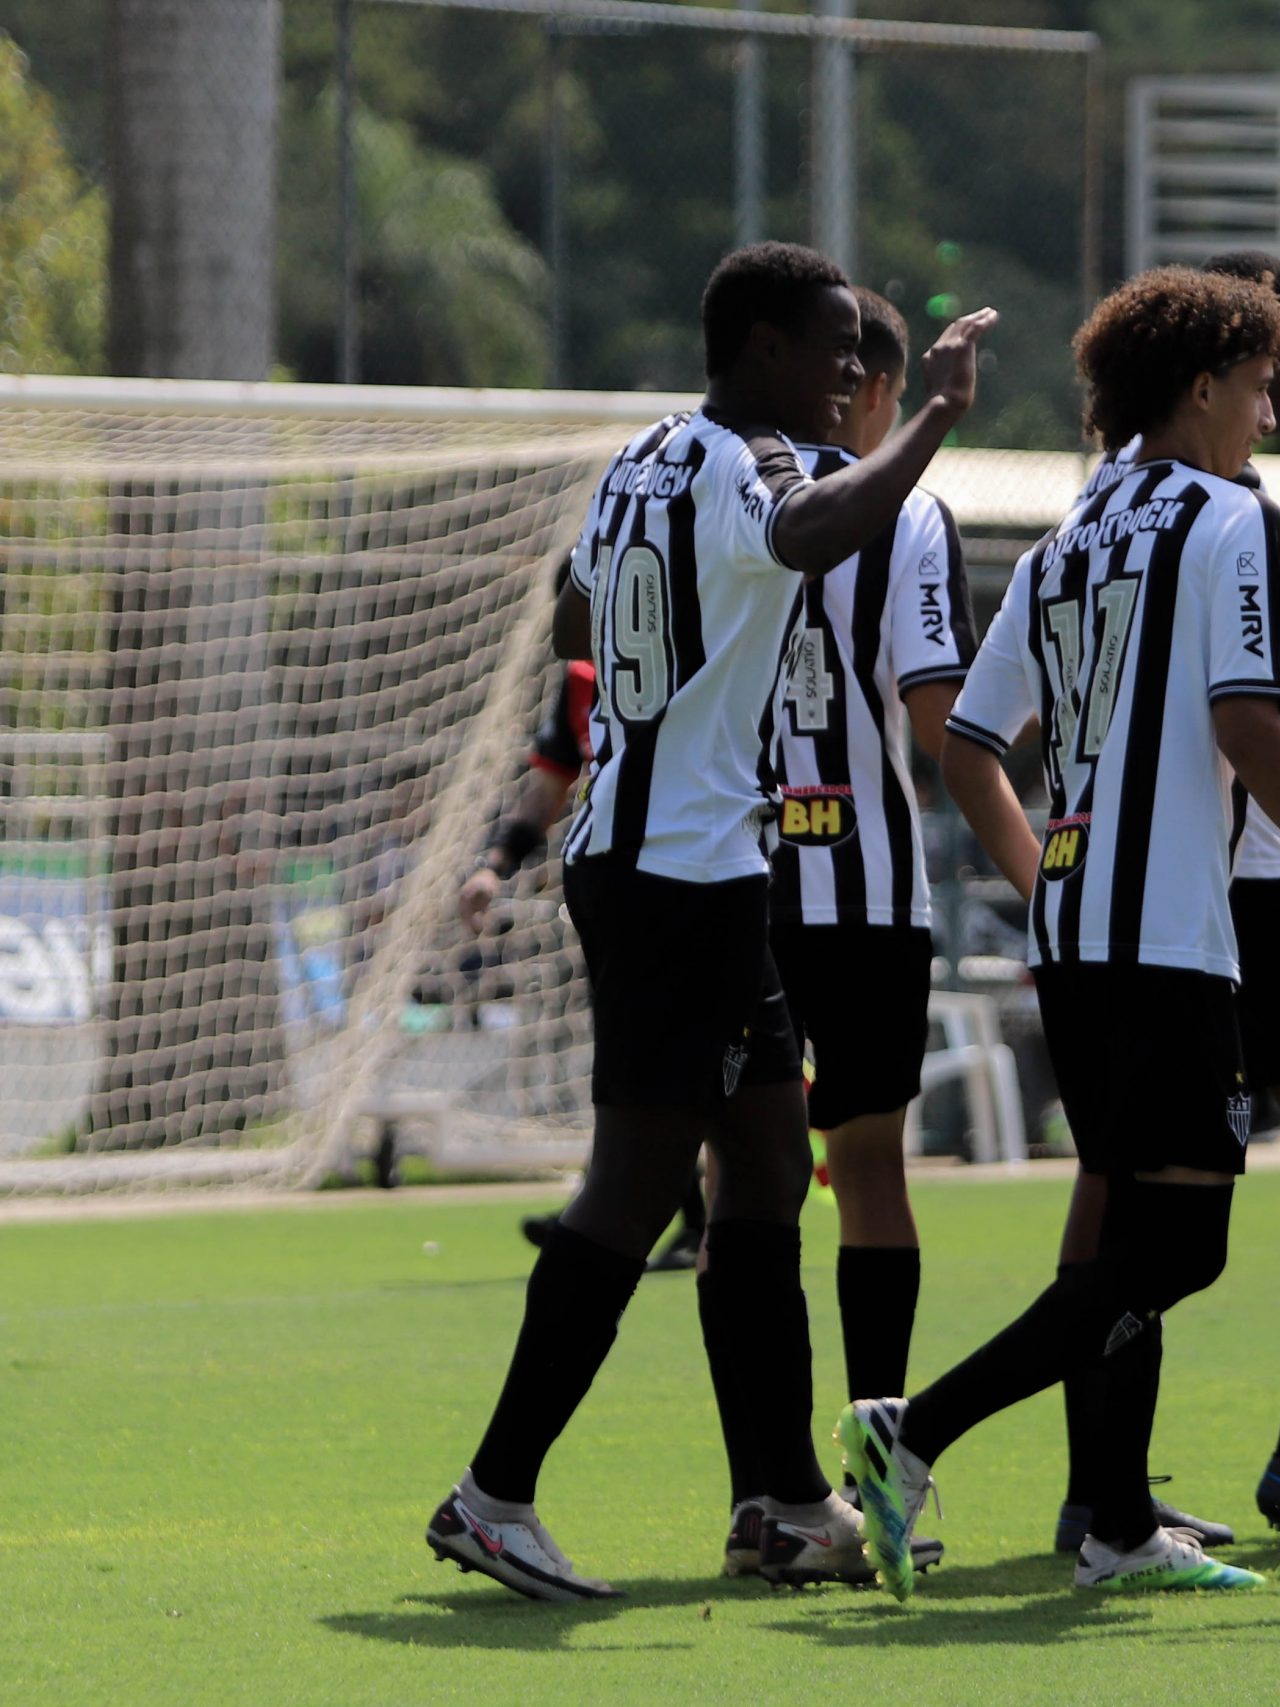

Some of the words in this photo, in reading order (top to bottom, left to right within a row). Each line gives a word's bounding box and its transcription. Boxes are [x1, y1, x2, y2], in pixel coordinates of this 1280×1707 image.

[646, 574, 656, 634] SOLATIO
[919, 583, 946, 647] MRV
[1239, 585, 1265, 659] MRV
[803, 641, 817, 699] SOLATIO
[1100, 635, 1118, 694] SOLATIO
[783, 799, 841, 834] BH
[1043, 829, 1080, 869] BH
